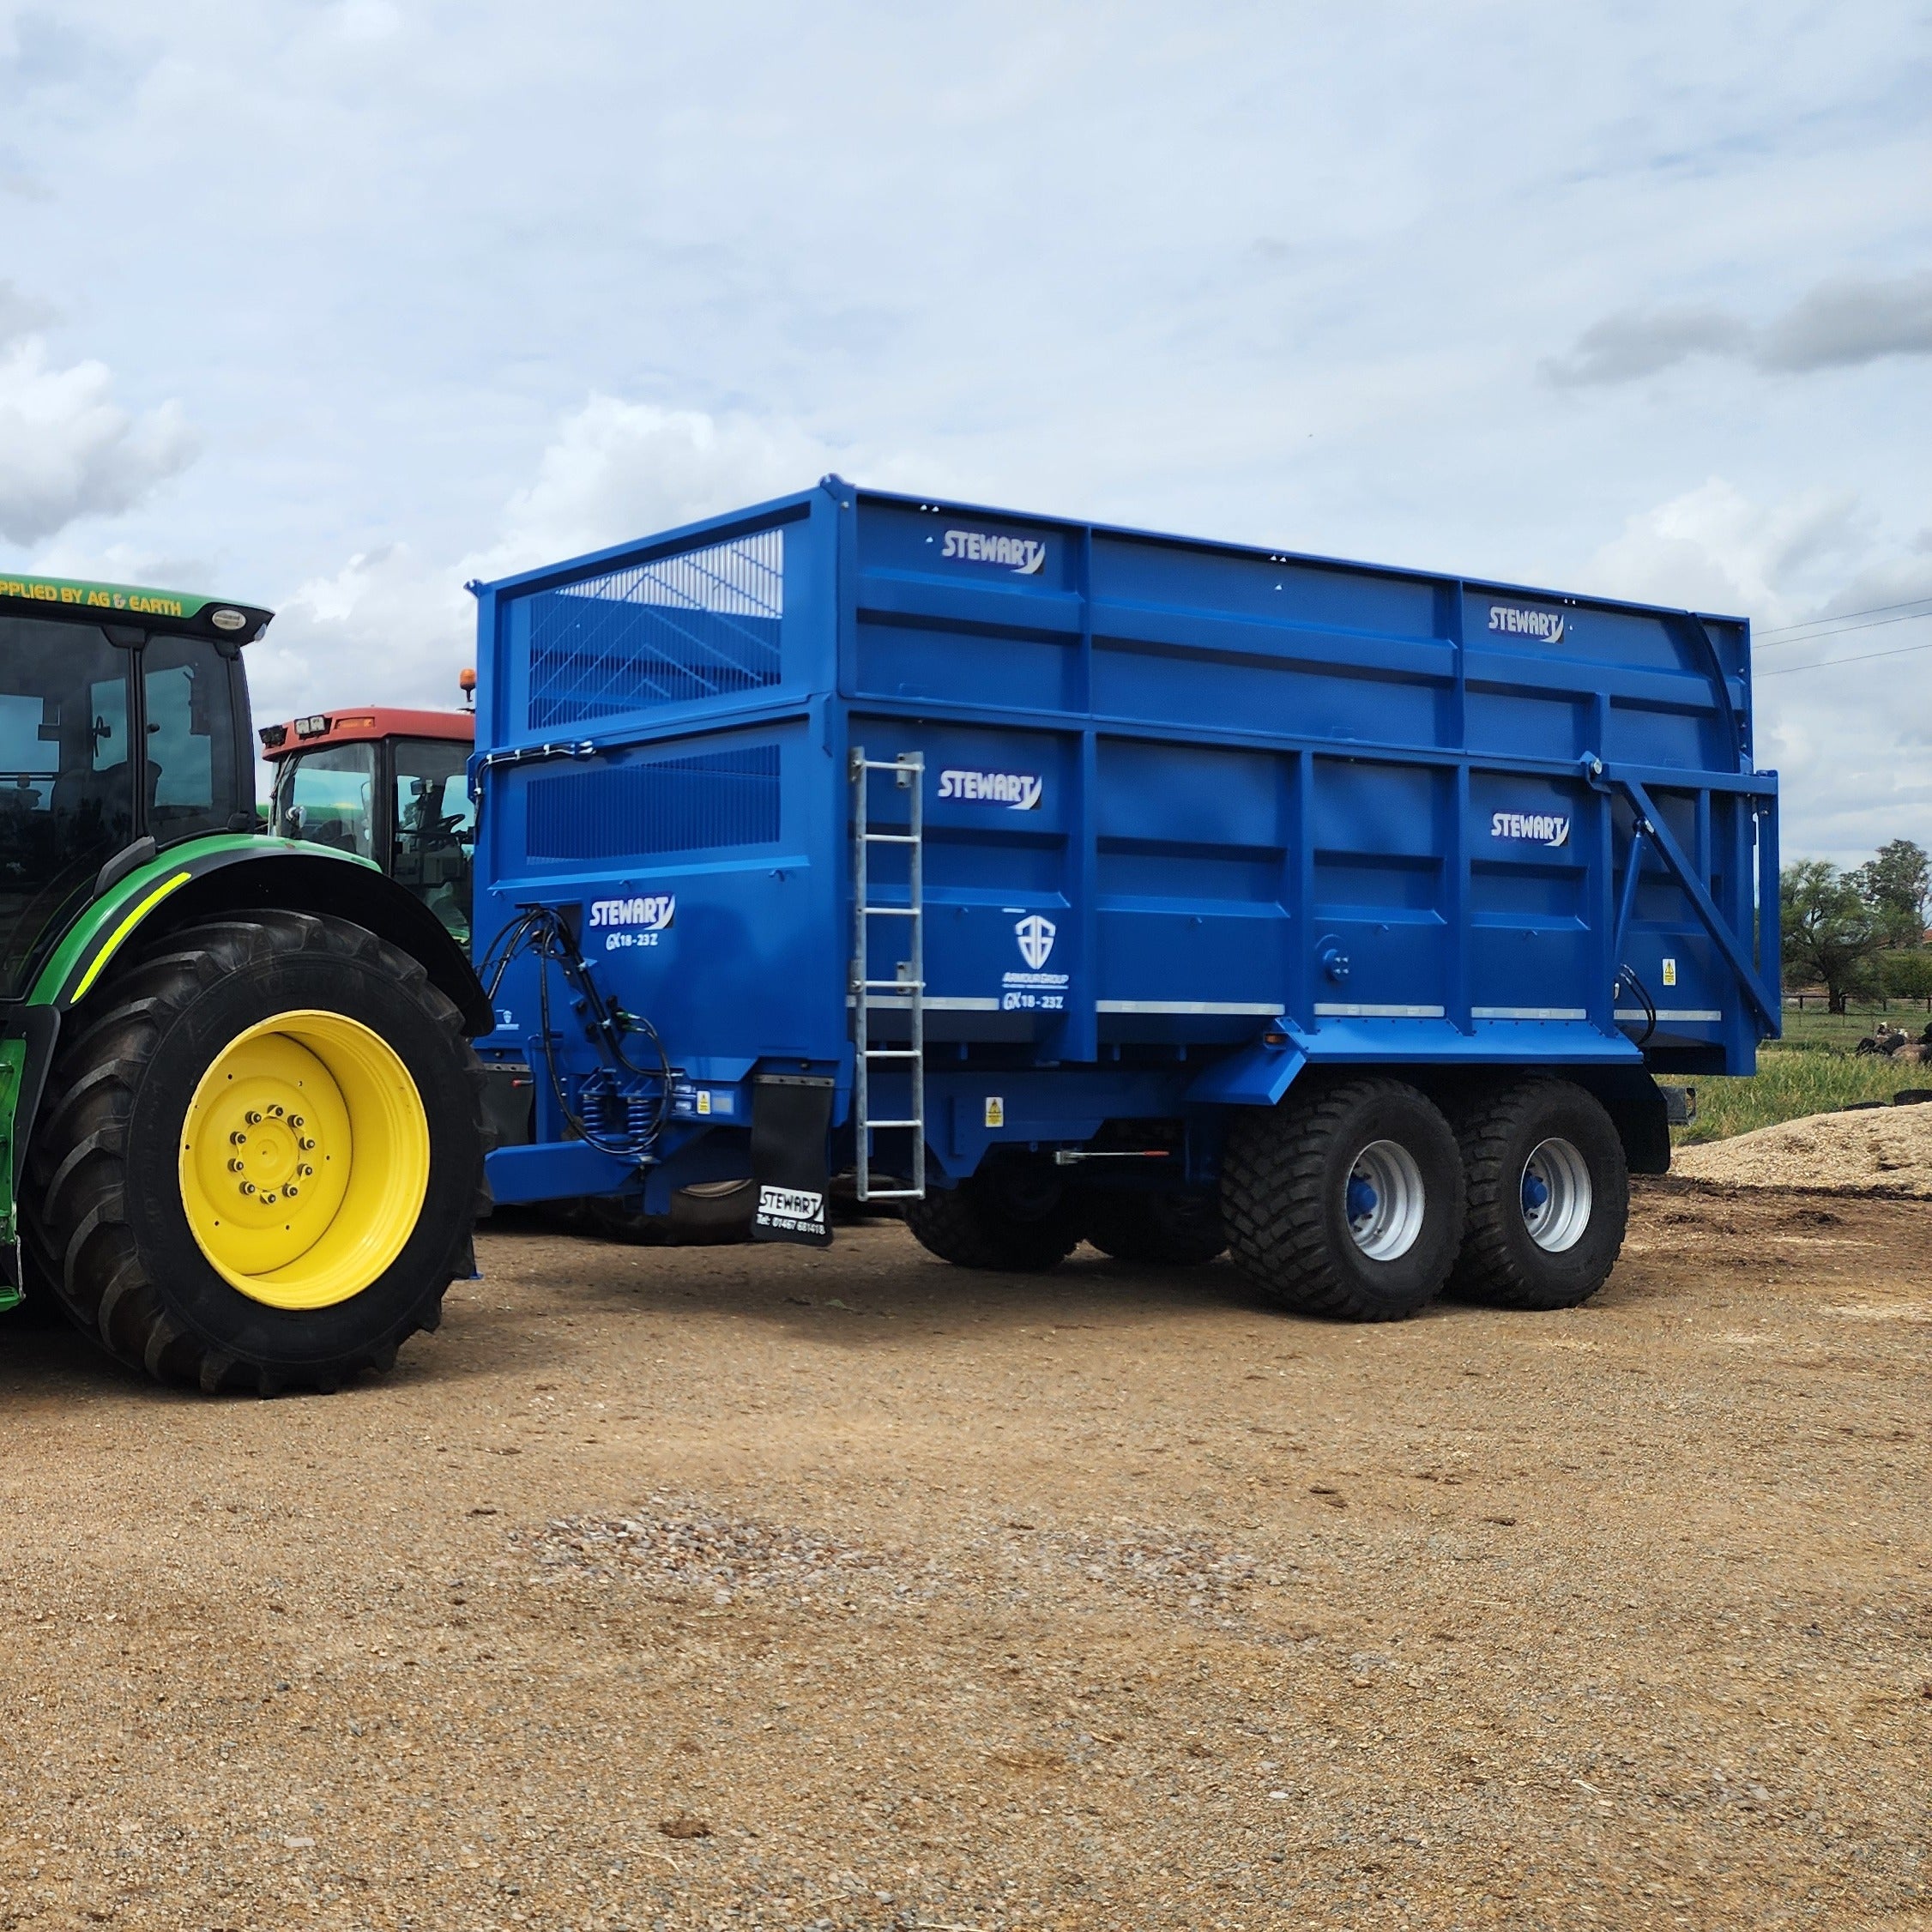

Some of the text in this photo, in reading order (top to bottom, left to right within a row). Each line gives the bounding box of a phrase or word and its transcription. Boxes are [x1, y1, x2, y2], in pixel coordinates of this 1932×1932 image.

[942, 529, 1046, 575] STEWART
[61, 587, 82, 604] BY
[88, 590, 109, 607] AG
[113, 592, 125, 610] &
[129, 595, 182, 616] EARTH
[1488, 607, 1565, 643] STEWART
[938, 770, 1042, 810] STEWART
[1491, 812, 1570, 847] STEWART
[589, 894, 676, 930] STEWART
[759, 1191, 822, 1219] STEWART
